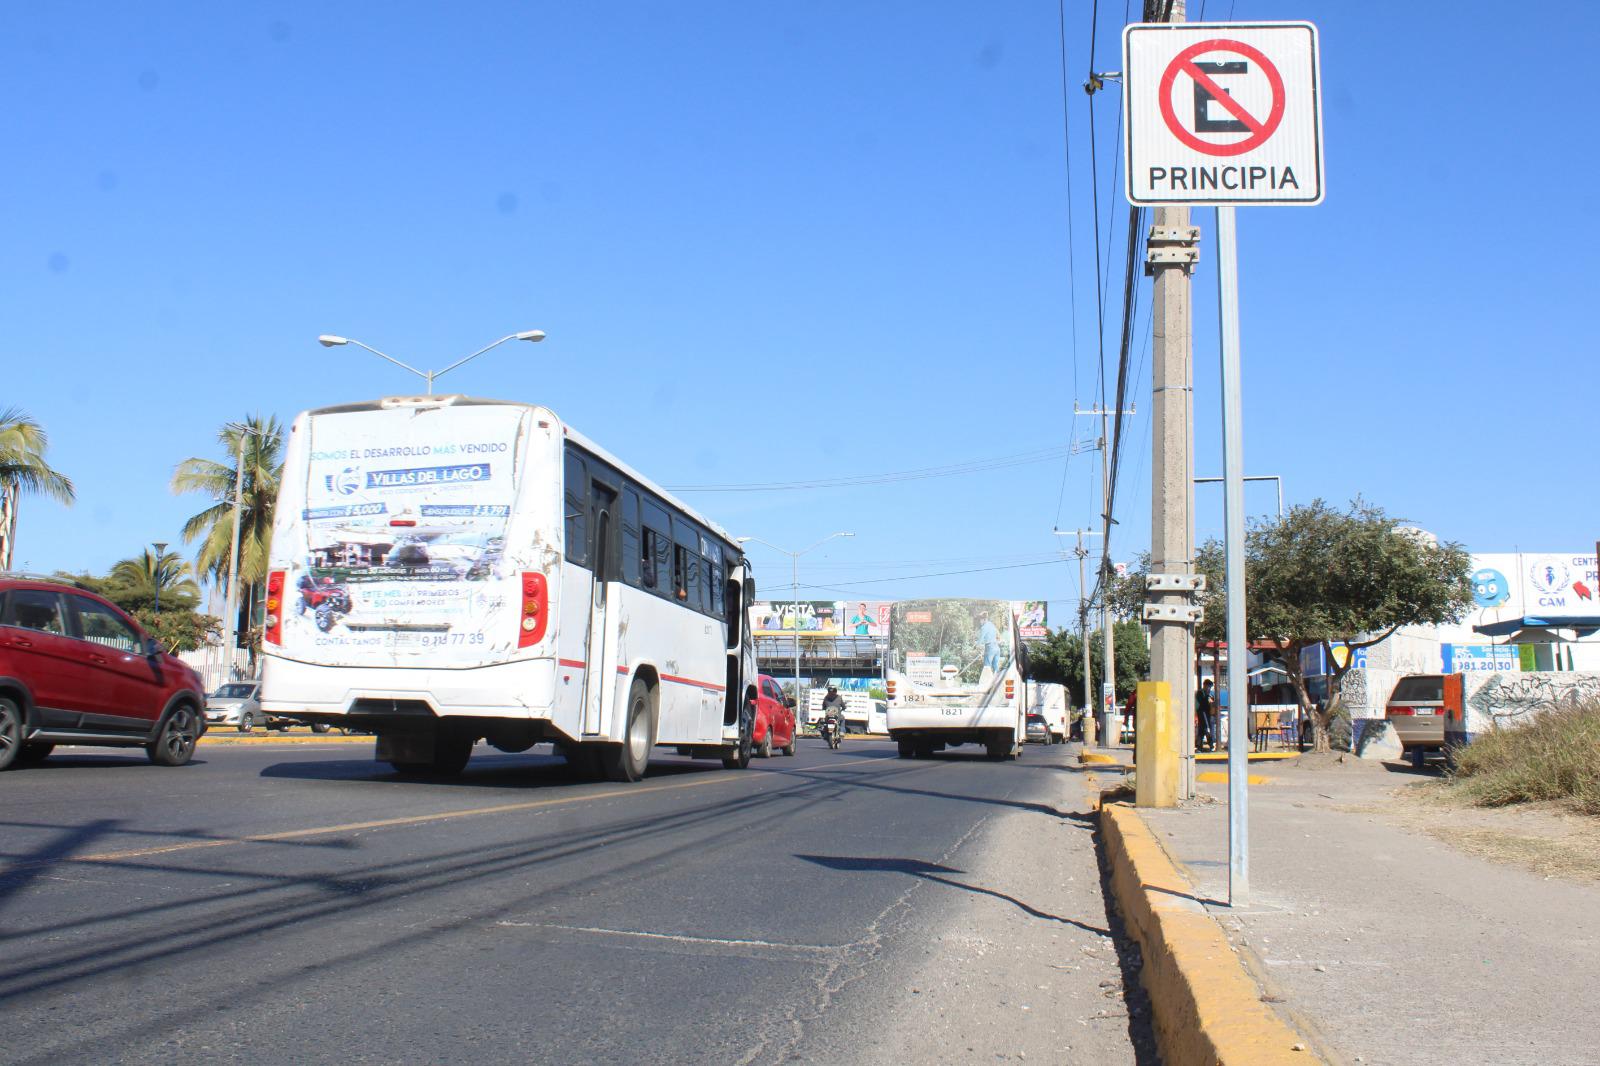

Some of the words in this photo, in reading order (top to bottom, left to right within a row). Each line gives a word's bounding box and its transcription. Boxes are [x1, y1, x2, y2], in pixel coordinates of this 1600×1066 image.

[1193, 61, 1252, 133] E
[1149, 165, 1299, 191] PRINCIPIA
[350, 449, 361, 459] EL
[364, 446, 431, 458] DESARROLLO
[460, 442, 508, 454] VENDIDO
[418, 470, 439, 484] DEL
[443, 466, 482, 482] LAGO
[1539, 597, 1566, 607] CAM
[776, 604, 816, 616] VISITA
[903, 694, 926, 703] 1821
[941, 708, 963, 716] 1821
